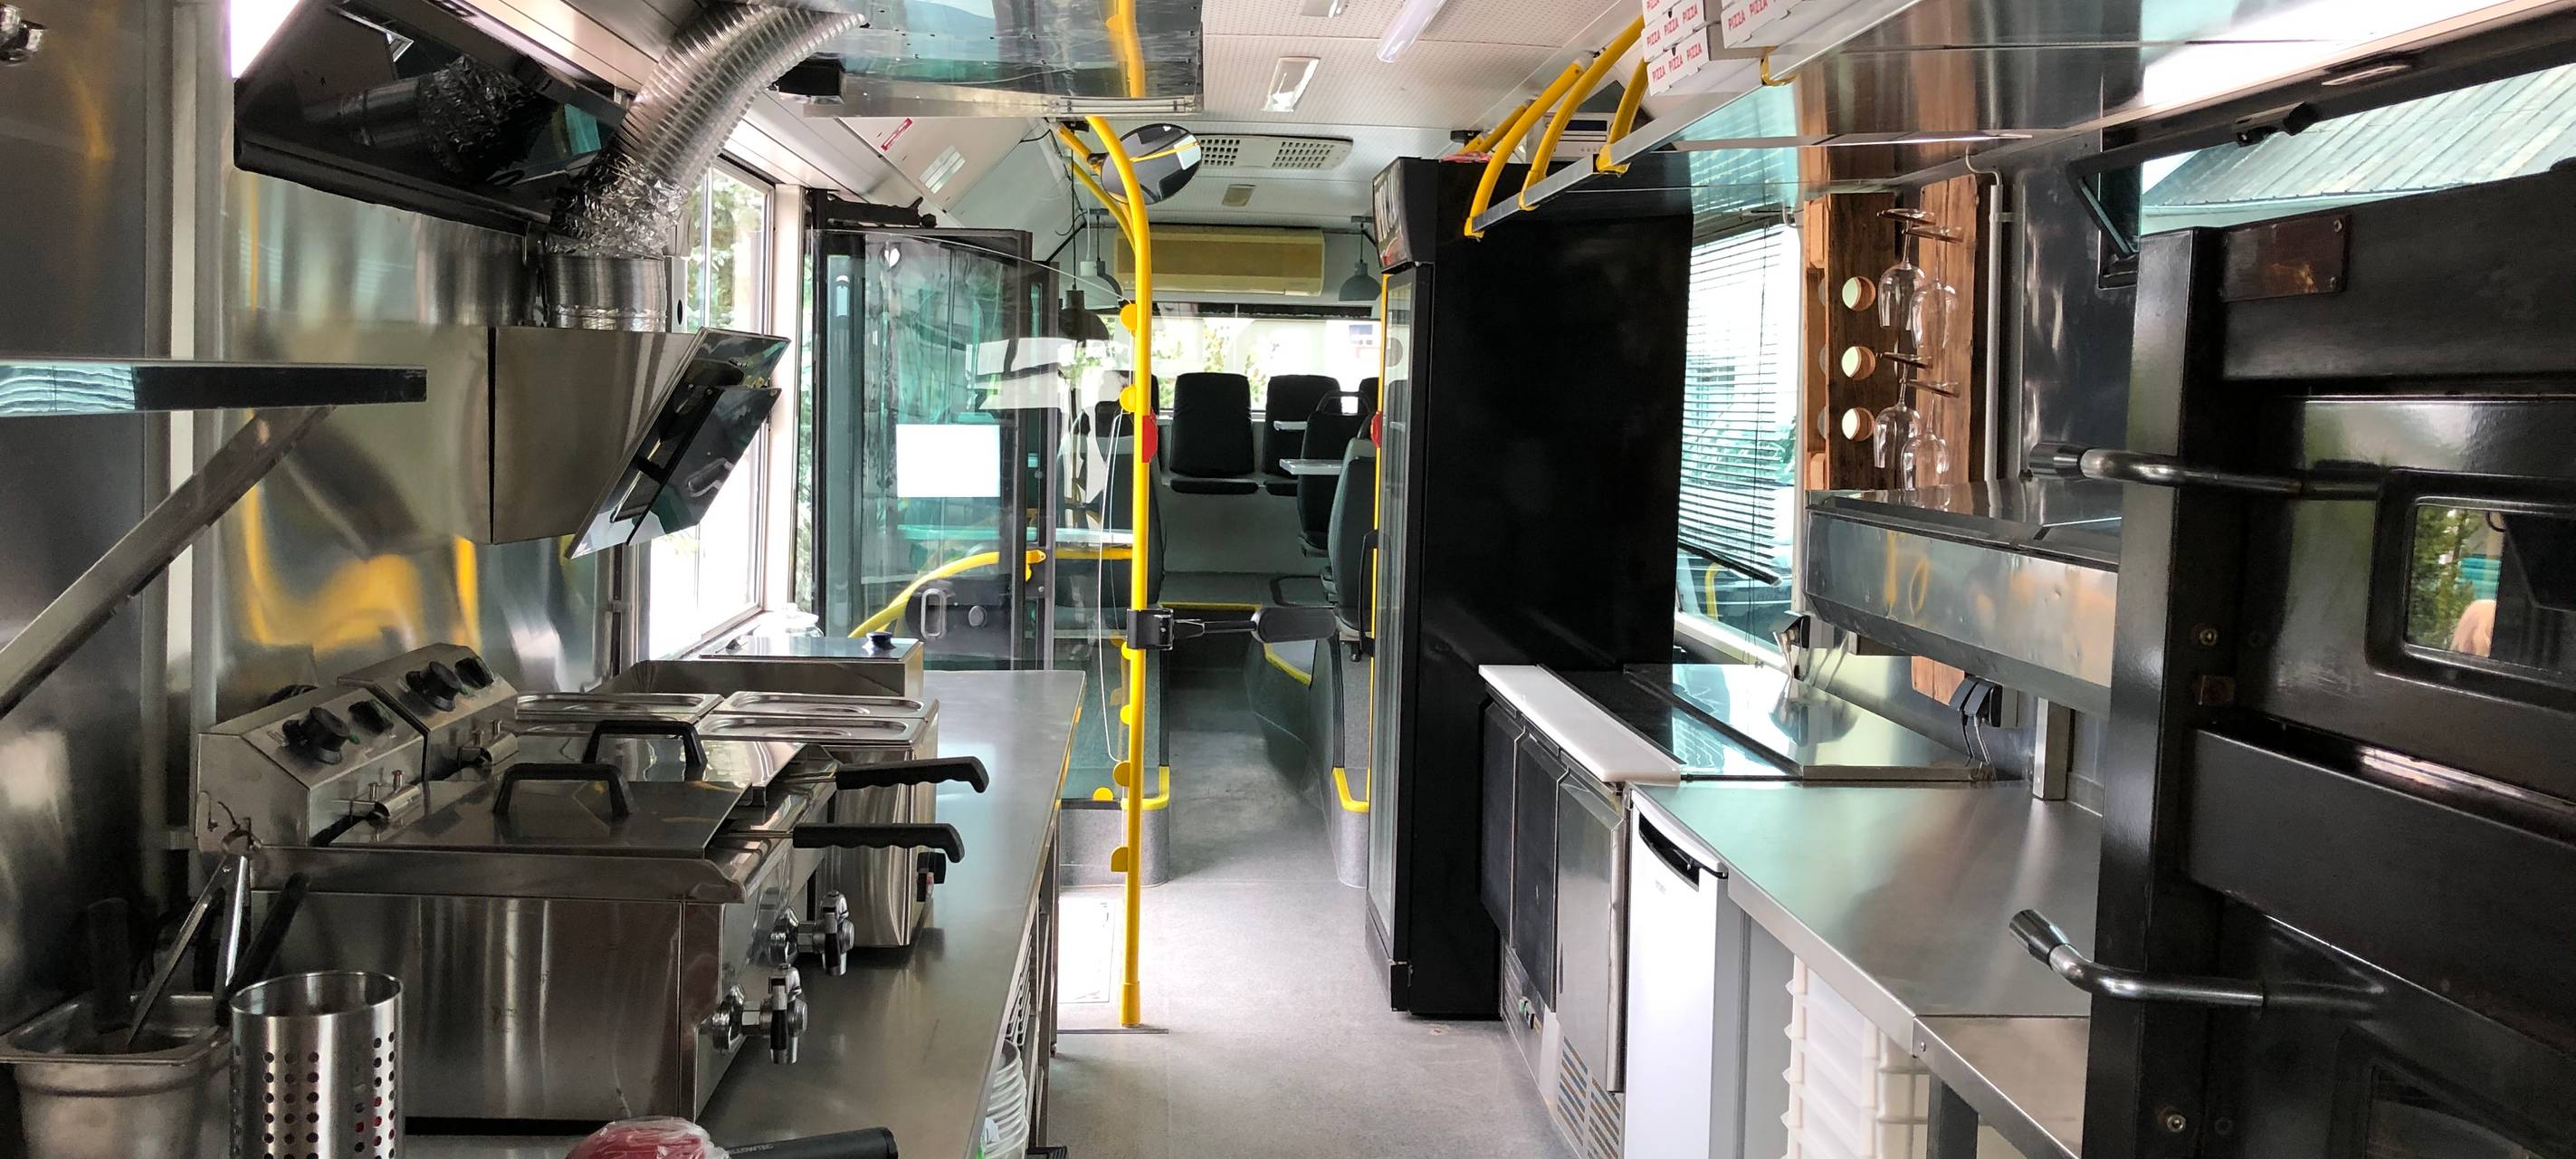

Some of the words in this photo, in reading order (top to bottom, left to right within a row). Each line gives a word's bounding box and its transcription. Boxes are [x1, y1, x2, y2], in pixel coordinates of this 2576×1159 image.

[1646, 30, 1661, 46] PIZZA
[1665, 18, 1679, 35] PIZZA
[1683, 5, 1698, 23] PIZZA
[1728, 9, 1745, 30] PIZZA
[1652, 65, 1665, 81] PIZZA
[1669, 54, 1684, 72] PIZZA
[1686, 43, 1702, 61] PIZZA
